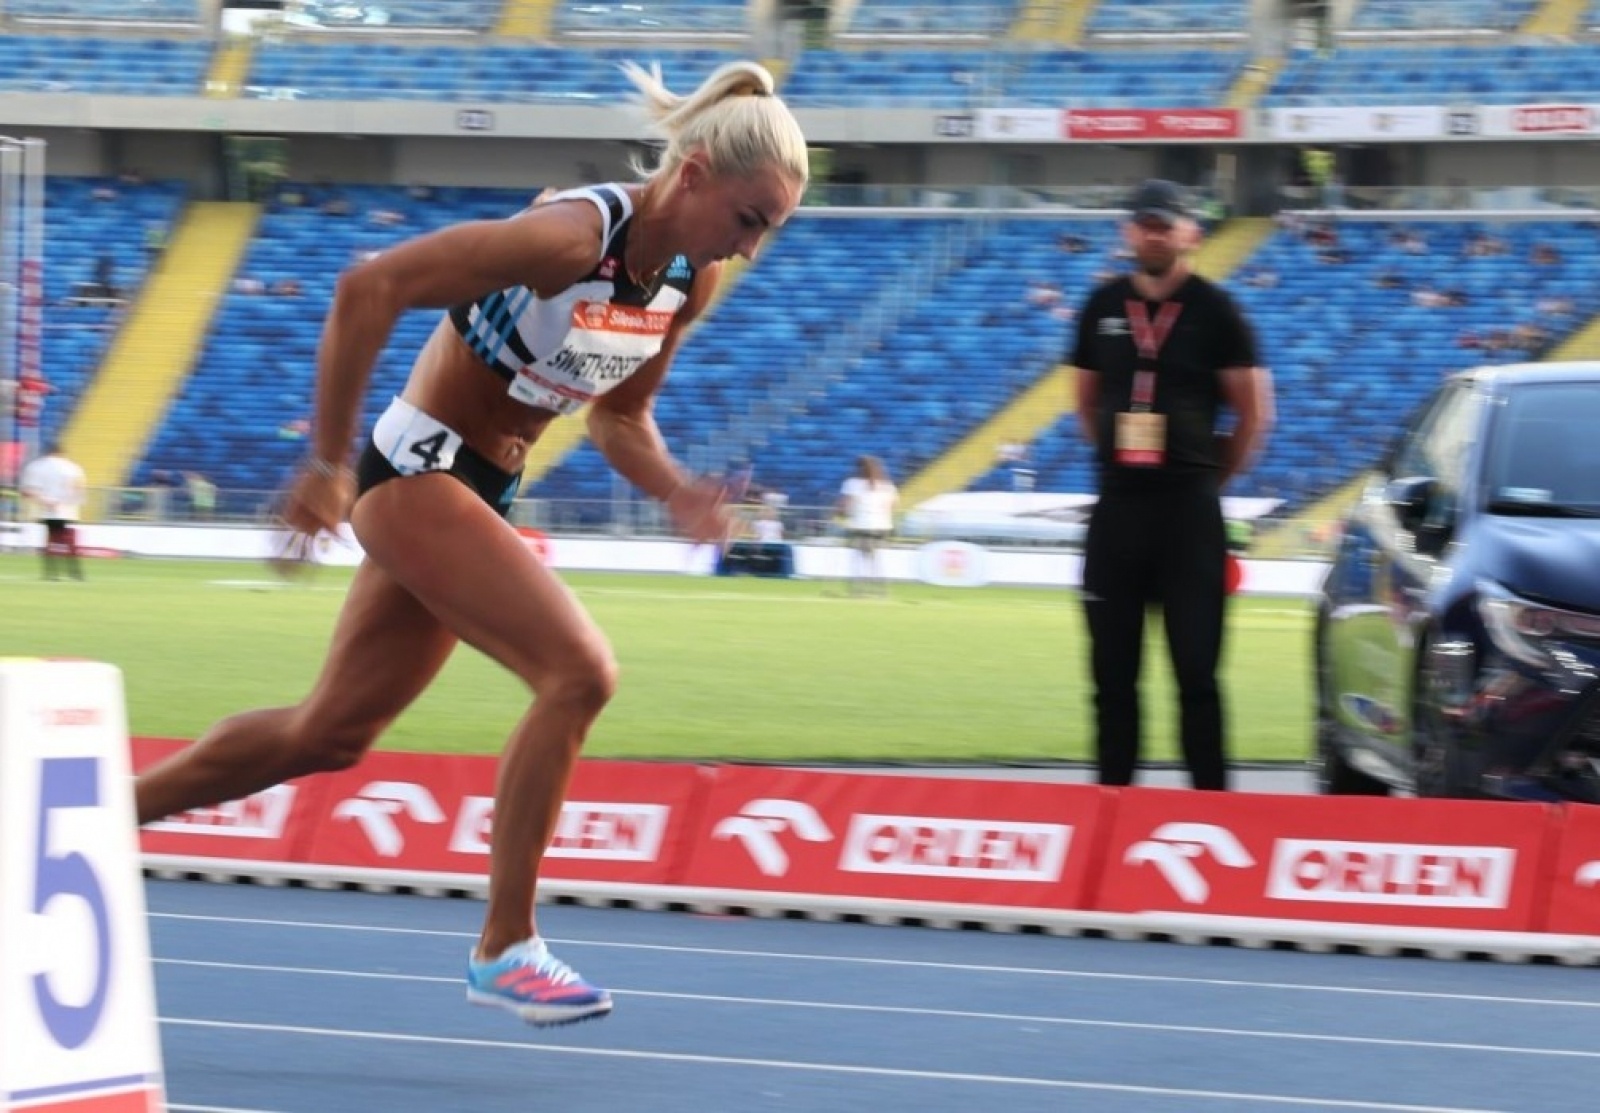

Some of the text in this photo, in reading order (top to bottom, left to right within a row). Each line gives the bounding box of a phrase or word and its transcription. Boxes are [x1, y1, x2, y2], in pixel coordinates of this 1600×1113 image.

[410, 429, 449, 468] 4
[864, 825, 1051, 871] ORLEN
[1290, 849, 1493, 899] ORLEN
[33, 757, 111, 1050] 5
